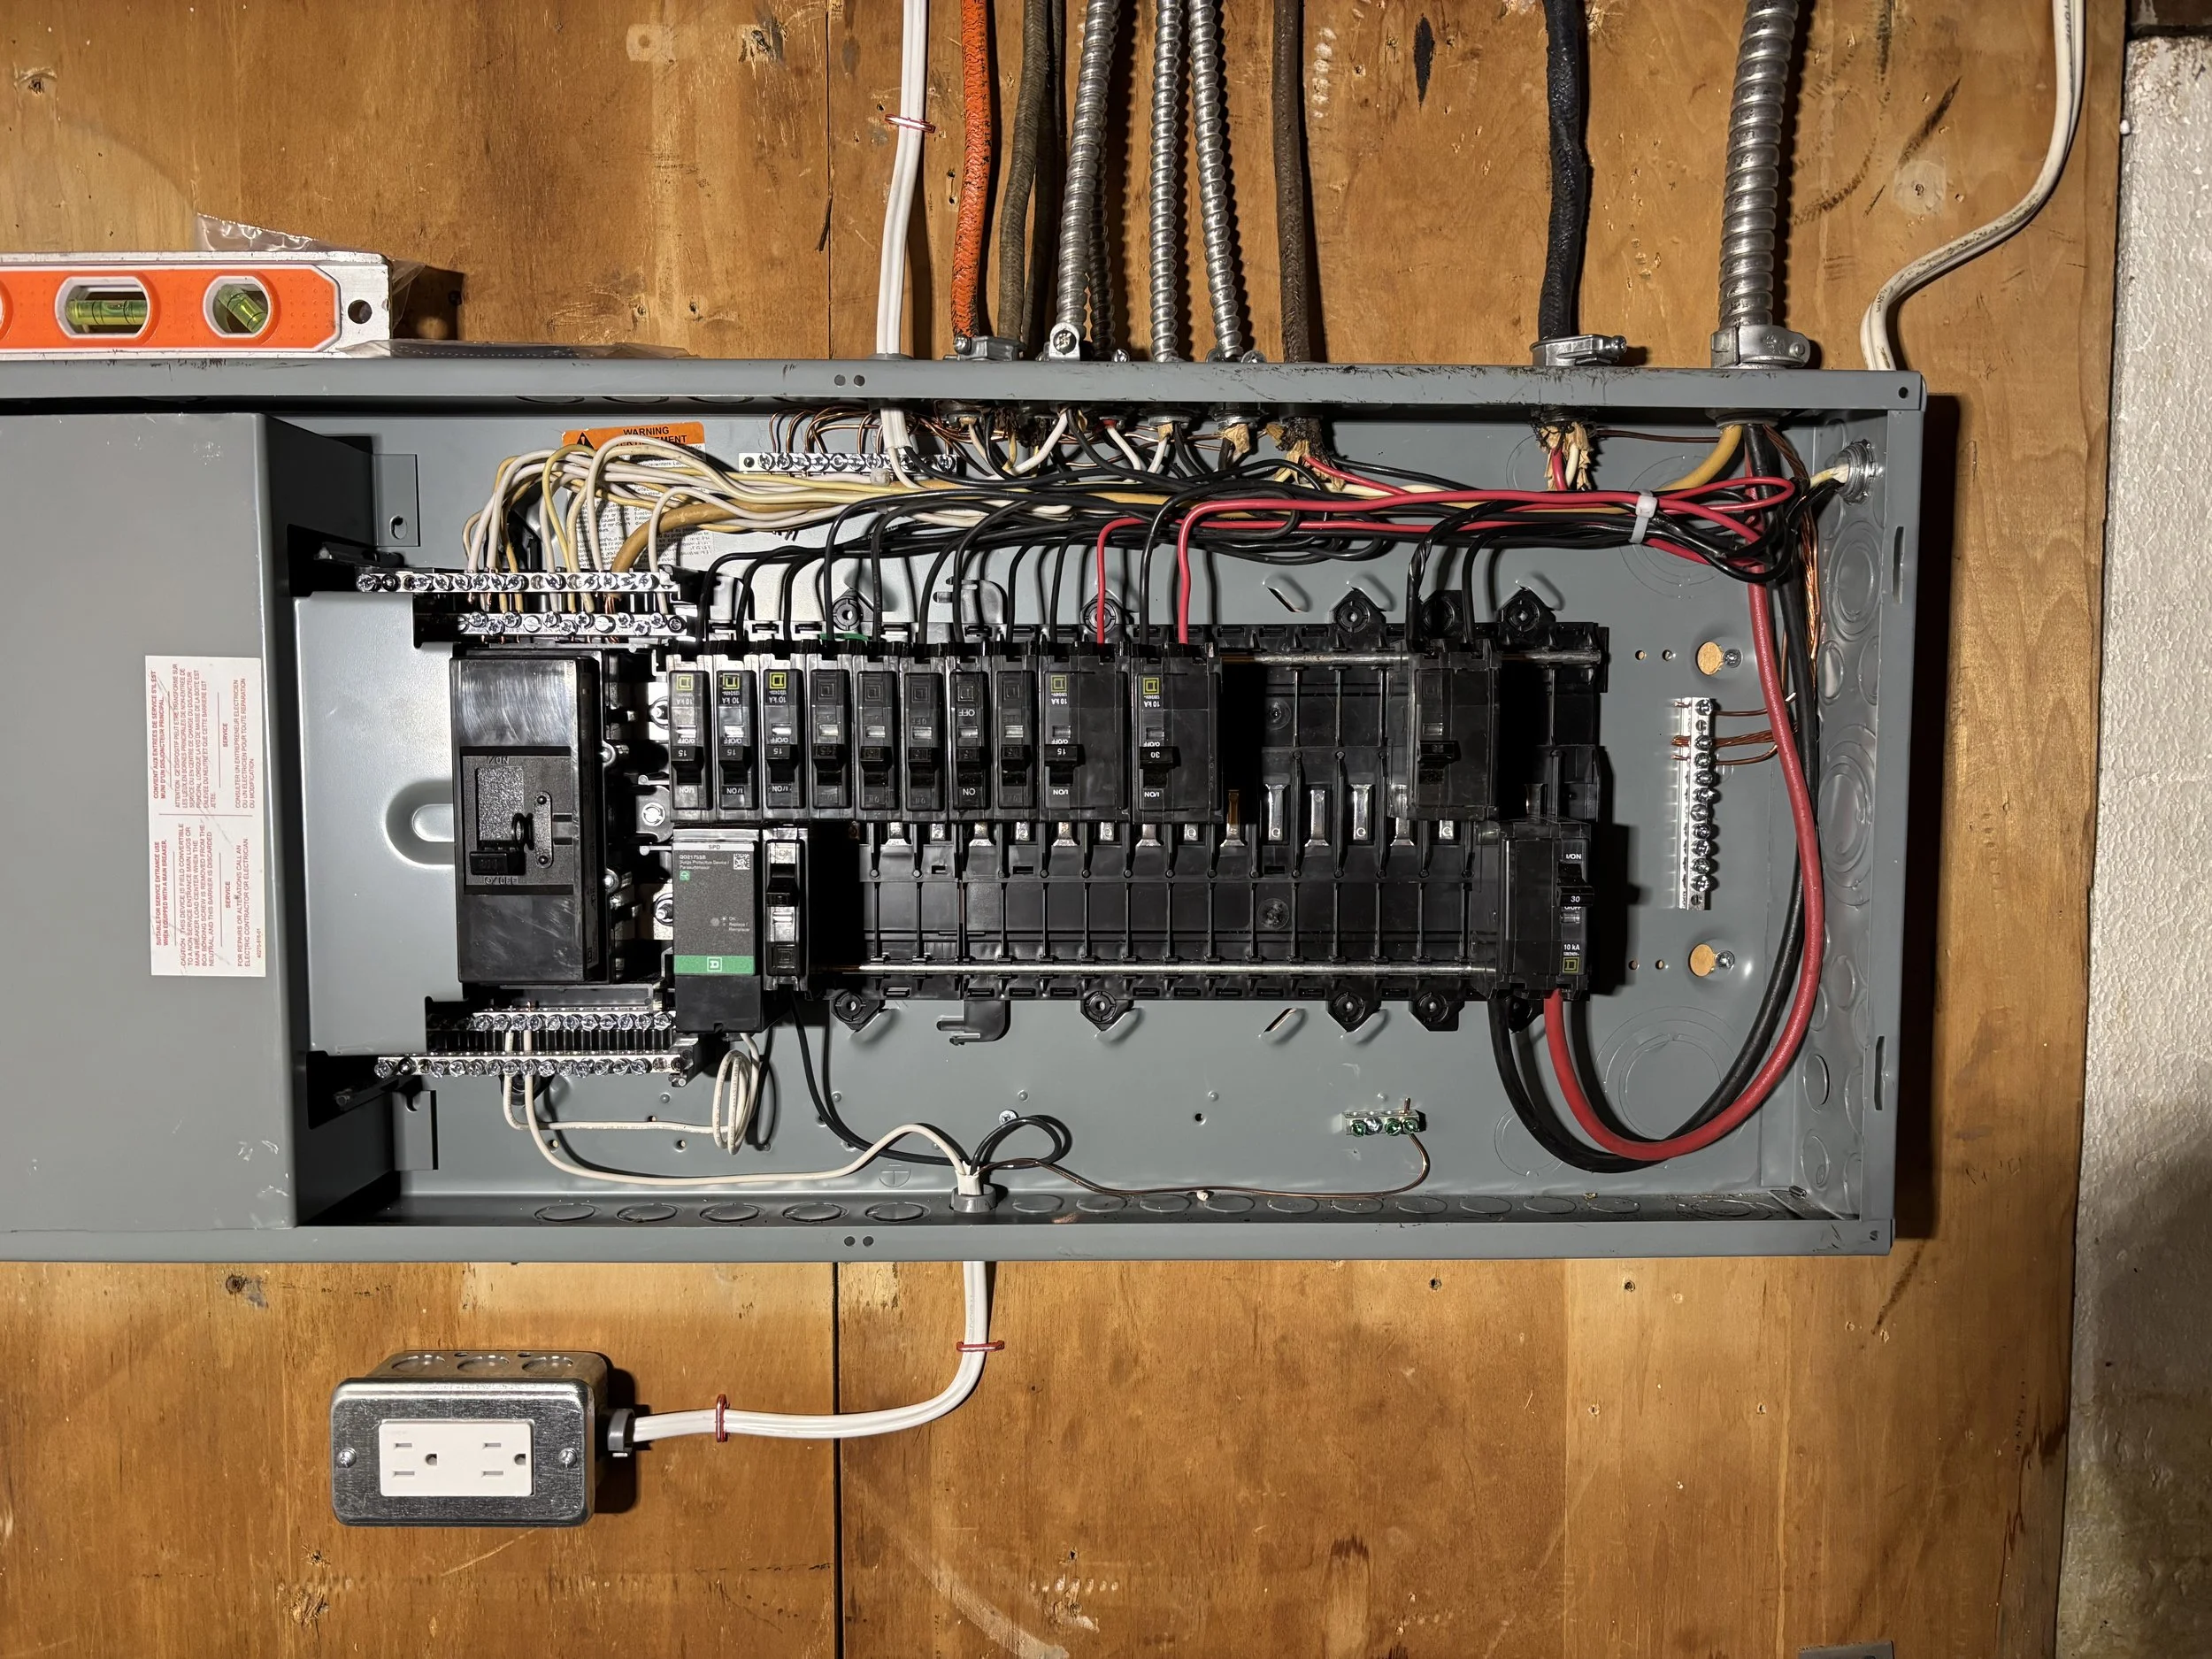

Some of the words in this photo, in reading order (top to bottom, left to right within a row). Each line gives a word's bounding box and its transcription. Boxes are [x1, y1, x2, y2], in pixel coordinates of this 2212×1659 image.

[623, 426, 670, 435] WARNING
[185, 826, 190, 836] OR
[236, 845, 241, 853] AN
[243, 881, 248, 890] OR
[237, 915, 242, 924] OR
